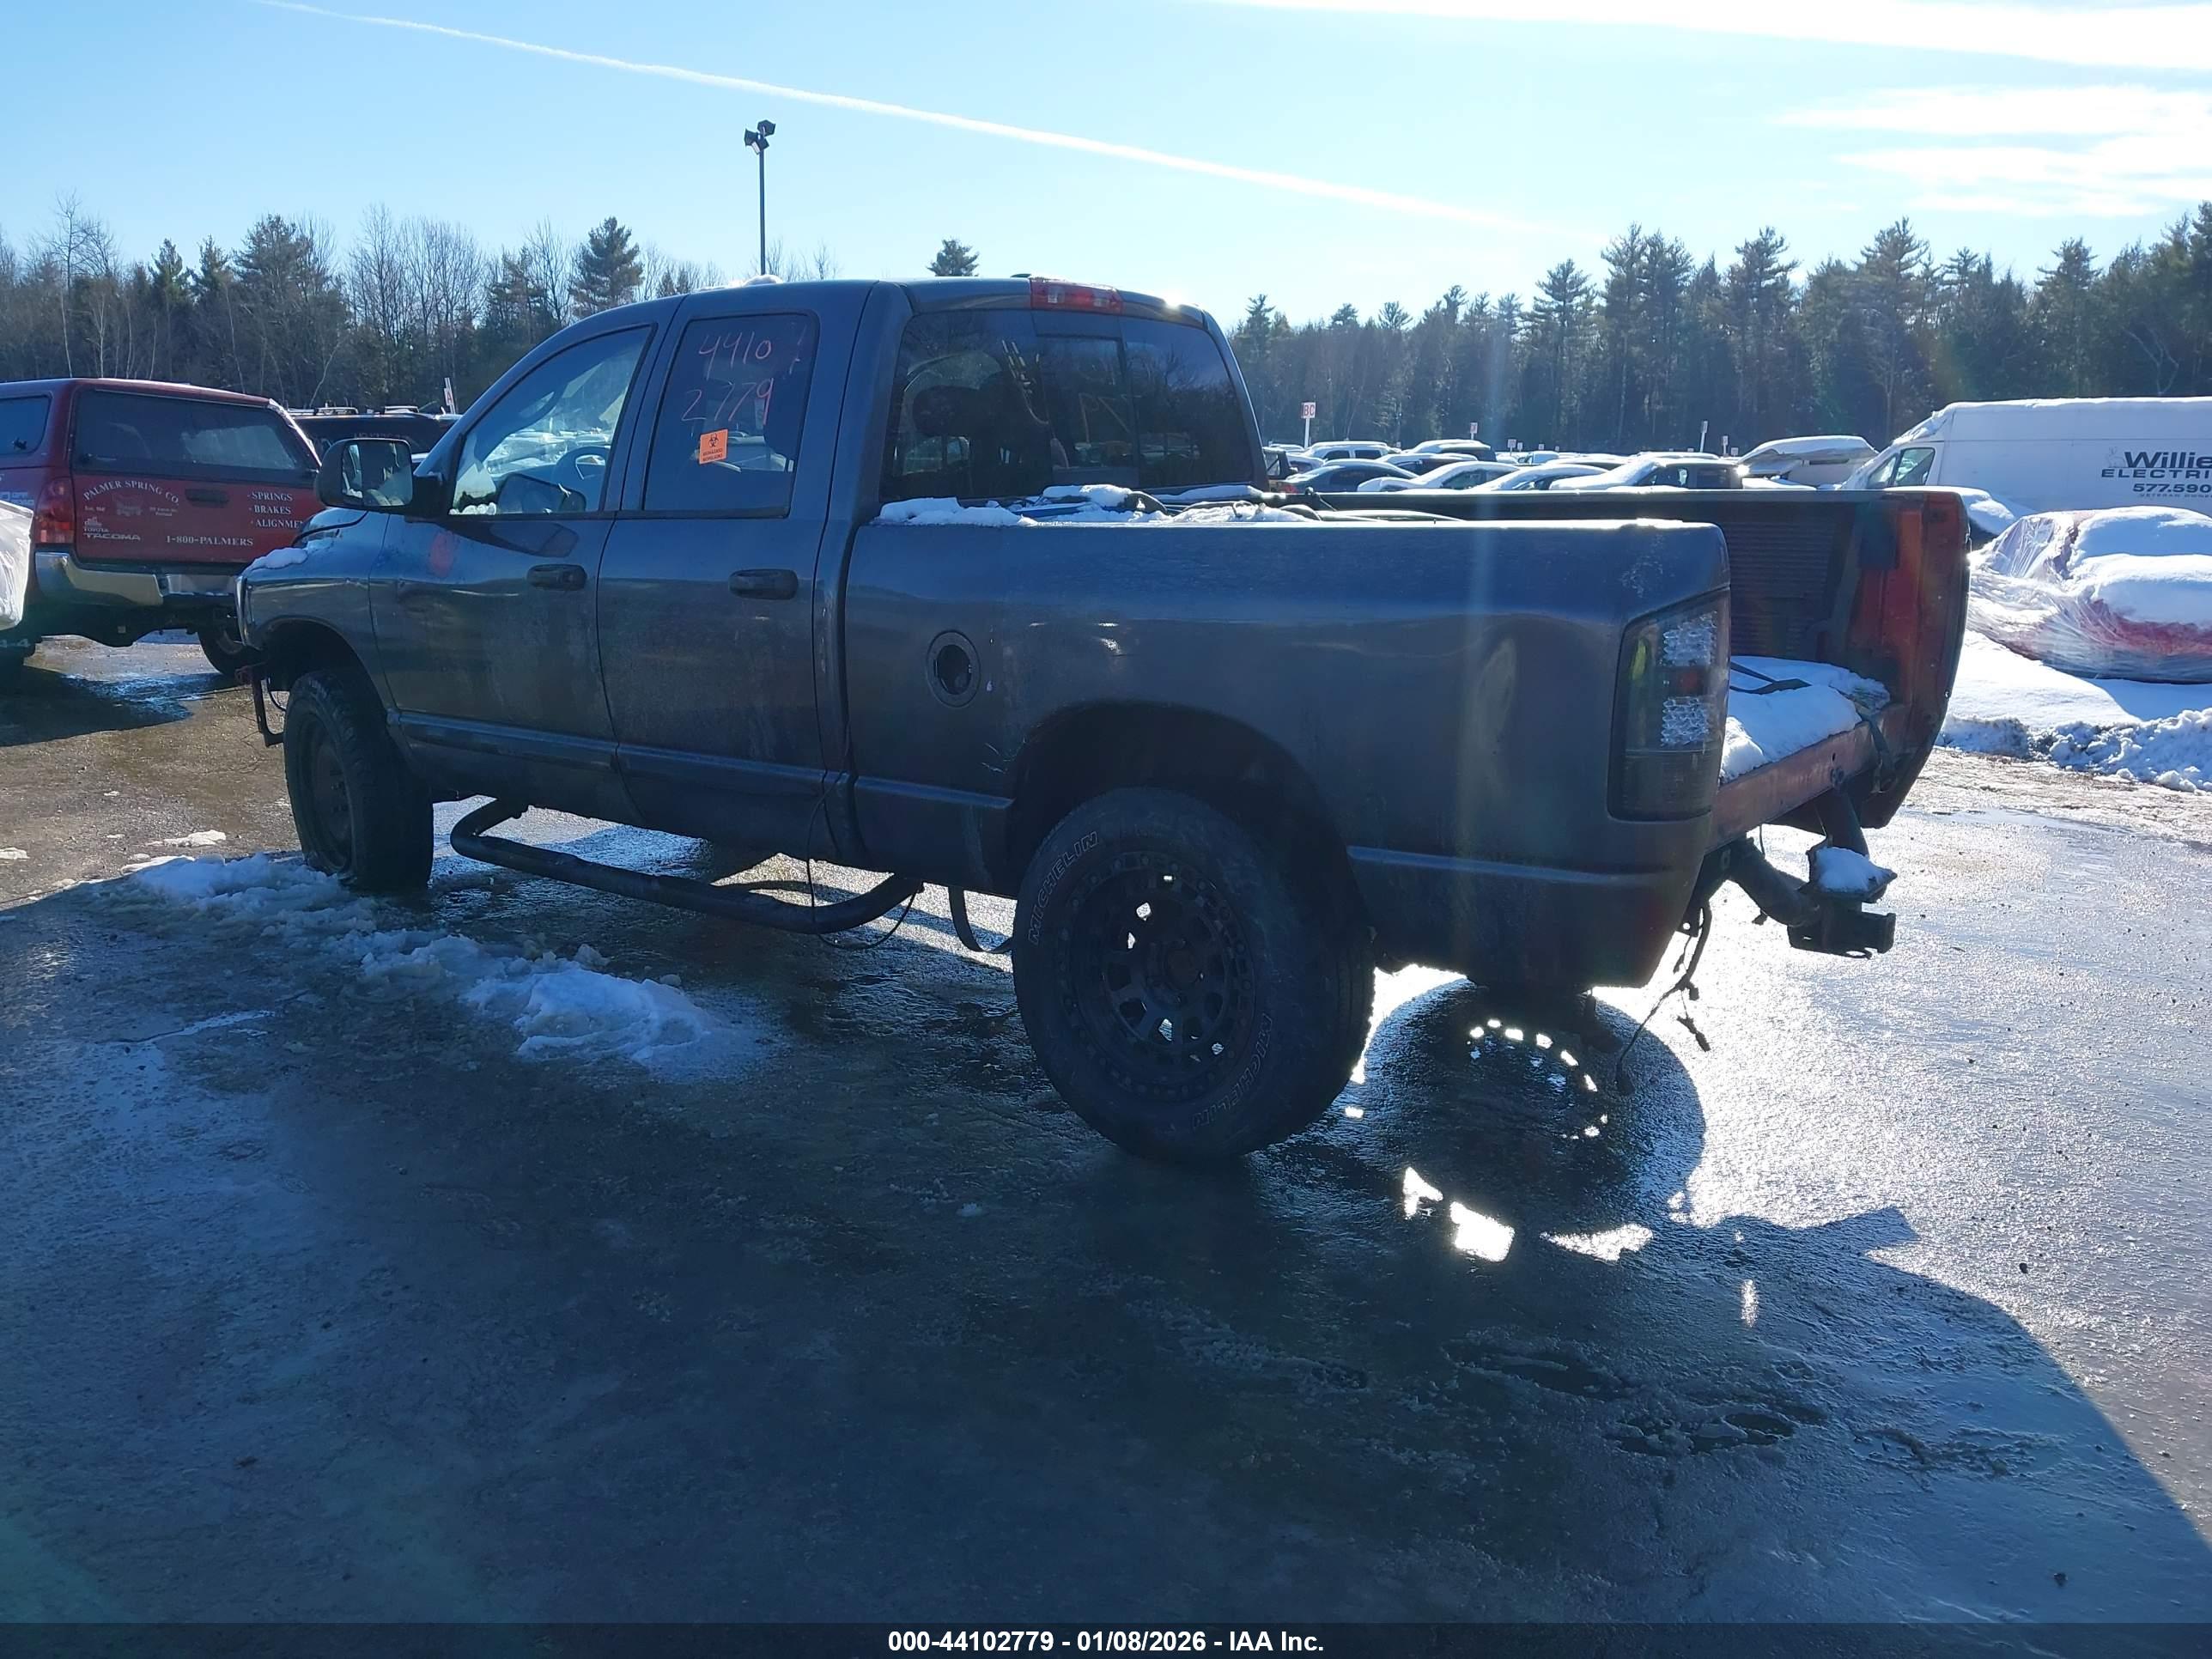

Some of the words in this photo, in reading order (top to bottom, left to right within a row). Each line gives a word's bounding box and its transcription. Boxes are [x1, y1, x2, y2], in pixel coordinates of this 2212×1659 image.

[699, 331, 772, 380] 4410
[681, 378, 775, 425] 2779
[2101, 469, 2210, 479] ELECTRI
[83, 480, 122, 501] PALMER
[125, 480, 162, 495] SPRING
[165, 491, 179, 506] CO.
[252, 491, 293, 502] SPRINGS
[2133, 483, 2212, 493] 577.590
[253, 505, 291, 515] BRAKES
[167, 535, 254, 547] 1-800-PALMERS
[1028, 830, 1098, 945] MICHELIN
[1192, 1013, 1273, 1129] MICHELIN
